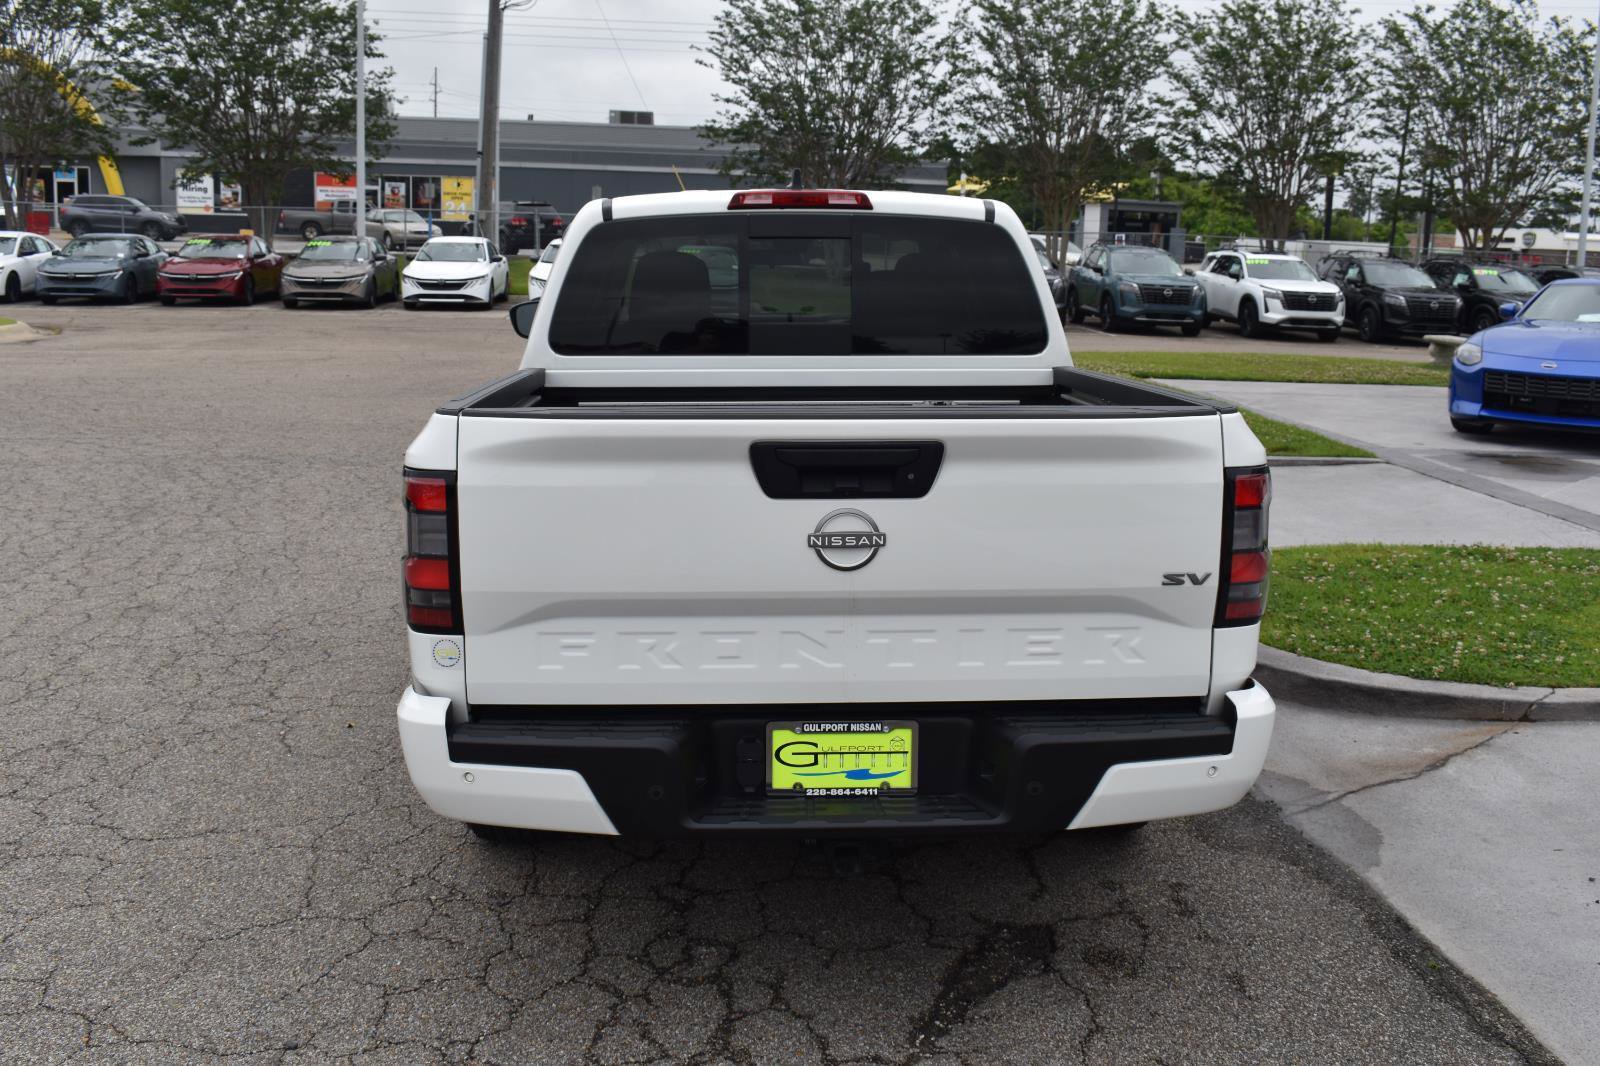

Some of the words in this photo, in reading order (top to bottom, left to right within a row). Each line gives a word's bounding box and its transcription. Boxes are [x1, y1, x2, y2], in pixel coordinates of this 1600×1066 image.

[810, 535, 884, 546] NISSAN
[1161, 572, 1212, 586] SV
[537, 627, 1147, 669] FRONTIER
[803, 723, 848, 732] GULFPORT
[850, 723, 882, 732] NISSAN
[806, 788, 878, 796] 228-864-6411
